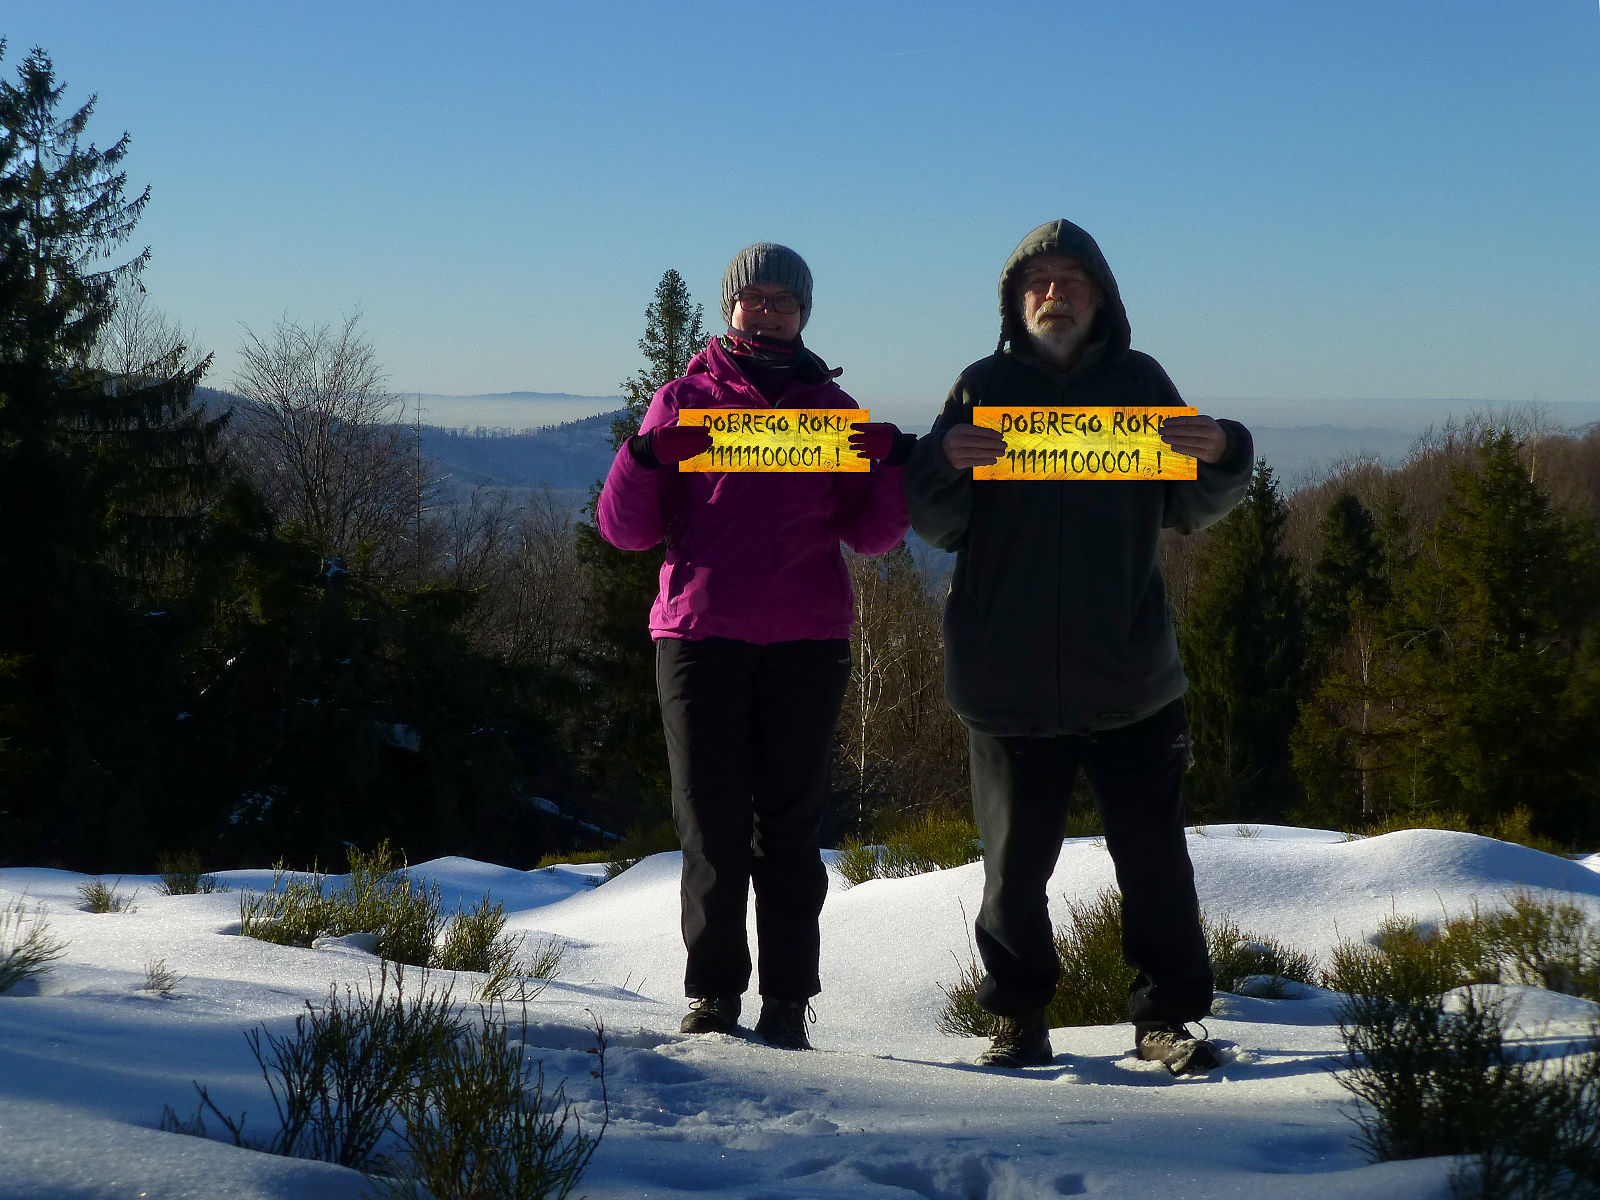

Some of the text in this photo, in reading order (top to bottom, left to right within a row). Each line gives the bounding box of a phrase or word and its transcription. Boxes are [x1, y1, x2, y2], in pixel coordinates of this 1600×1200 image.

[702, 412, 848, 435] DOBREGO ROKU
[1001, 411, 1103, 437] DOBREGO
